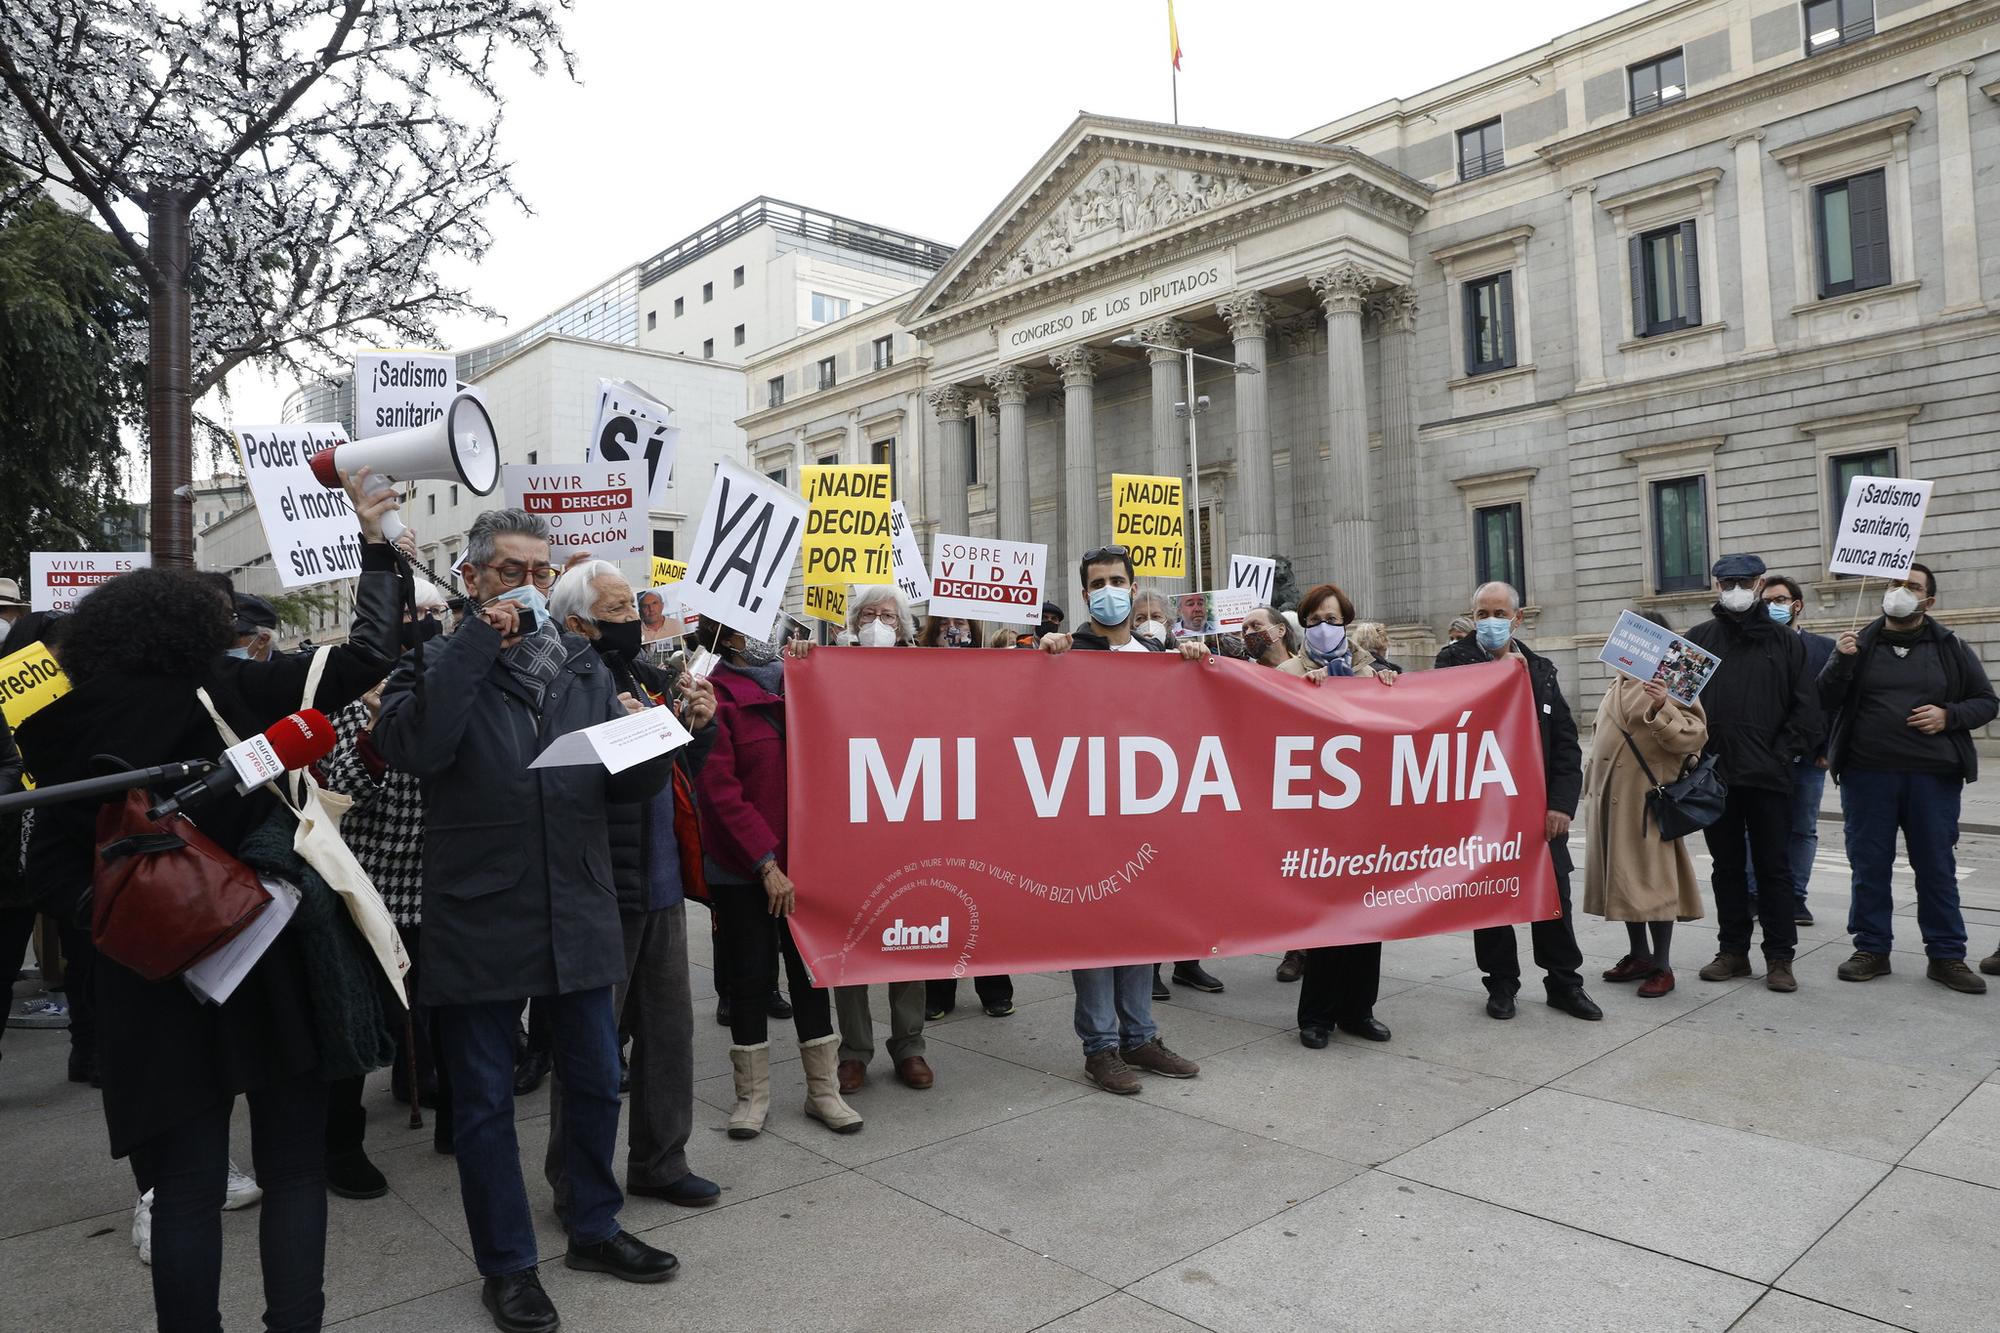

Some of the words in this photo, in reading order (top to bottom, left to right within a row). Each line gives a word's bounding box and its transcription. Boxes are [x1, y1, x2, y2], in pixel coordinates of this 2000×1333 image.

[1011, 315, 1073, 346] CONGRESO
[1082, 307, 1097, 324] DE
[1106, 297, 1130, 317] LOS
[1140, 267, 1218, 307] DIPUTADOS
[372, 359, 447, 393] ¡Sadismo
[242, 432, 298, 469] Poder
[528, 476, 583, 491] VIVIR
[607, 472, 627, 488] ES
[808, 472, 888, 503] ¡NADIE
[281, 486, 300, 522] el
[530, 497, 552, 510] UN
[561, 493, 627, 509] DERECHO
[1119, 482, 1180, 507] ¡NADIE
[1857, 483, 1921, 508] ¡Sadismo
[550, 515, 563, 528] O
[584, 510, 628, 527] UNA
[806, 509, 890, 537] DECIDA
[1117, 513, 1183, 537] DECIDA
[1852, 515, 1911, 542] sanitario,
[548, 527, 627, 547] BLIGACIÓN
[629, 545, 645, 553] dmd
[695, 476, 800, 614] YA!
[51, 560, 95, 570] VIVIR
[115, 560, 132, 570] ES
[290, 540, 322, 577] sin
[808, 546, 857, 574] POR
[864, 543, 890, 575] TÍ!
[942, 544, 1001, 562] SOBRE
[1013, 551, 1035, 566] MI
[1162, 542, 1182, 568] TÍ!
[1836, 547, 1876, 566] nunca
[1877, 548, 1915, 570] más!
[52, 575, 70, 584] UN
[78, 575, 117, 584] DERE
[654, 562, 687, 581] ¡NADIE
[941, 561, 1033, 585] VIDA
[52, 588, 78, 597] NO
[806, 586, 824, 609] EN
[825, 589, 845, 616] PAZ.
[939, 581, 1004, 601] DECIDO
[1008, 588, 1033, 604] YO
[1618, 656, 1633, 666] dmd
[245, 751, 268, 778] press
[255, 739, 279, 772] europa
[848, 737, 976, 823] MI
[1013, 735, 1242, 818] VIDA
[1272, 735, 1362, 810] ES
[1390, 710, 1519, 806] MÍA
[1280, 832, 1522, 879] #libreshastaelfinal
[886, 869, 903, 883] VIVIR
[904, 863, 918, 873] BIZI
[920, 858, 942, 869] VIURE
[945, 858, 966, 867] VIVIR
[969, 859, 987, 873] BIZI
[989, 864, 1017, 884] VIURE
[1019, 876, 1048, 898] VIVIR
[1049, 885, 1074, 904] BIZI
[1076, 875, 1121, 903] VIURE
[1117, 842, 1159, 883] VIVIR
[916, 879, 929, 887] HIL
[930, 878, 958, 894] MORIR
[1363, 875, 1520, 909] derechoamorir.org
[956, 889, 980, 932] MORRER
[882, 916, 950, 947] dmd
[963, 934, 979, 950] HIL
